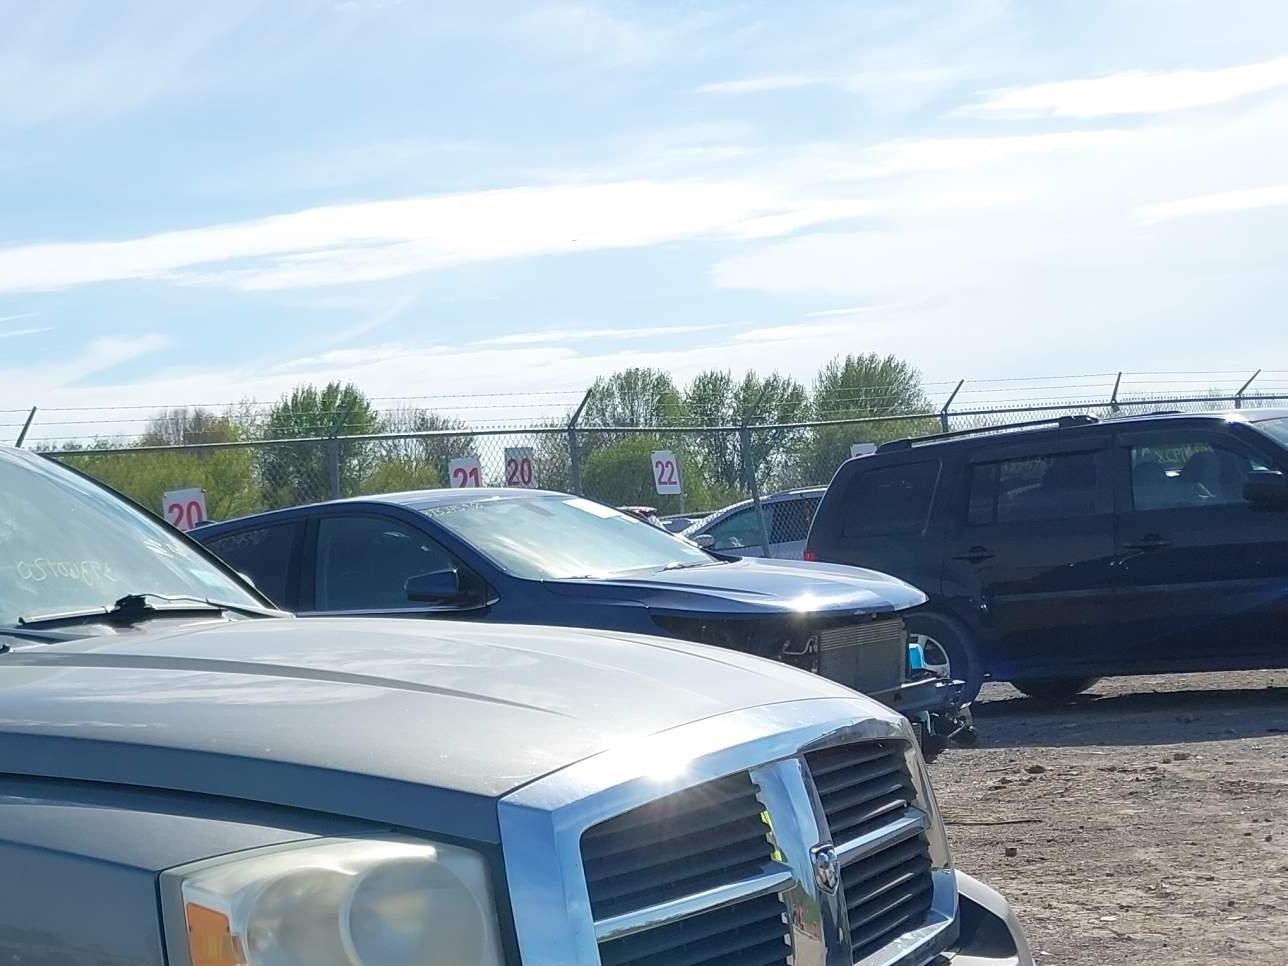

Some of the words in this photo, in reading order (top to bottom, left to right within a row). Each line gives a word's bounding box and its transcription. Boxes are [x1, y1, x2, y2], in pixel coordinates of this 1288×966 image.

[452, 466, 480, 488] 21
[506, 457, 533, 486] 20
[655, 460, 678, 486] 22
[167, 500, 203, 530] 20
